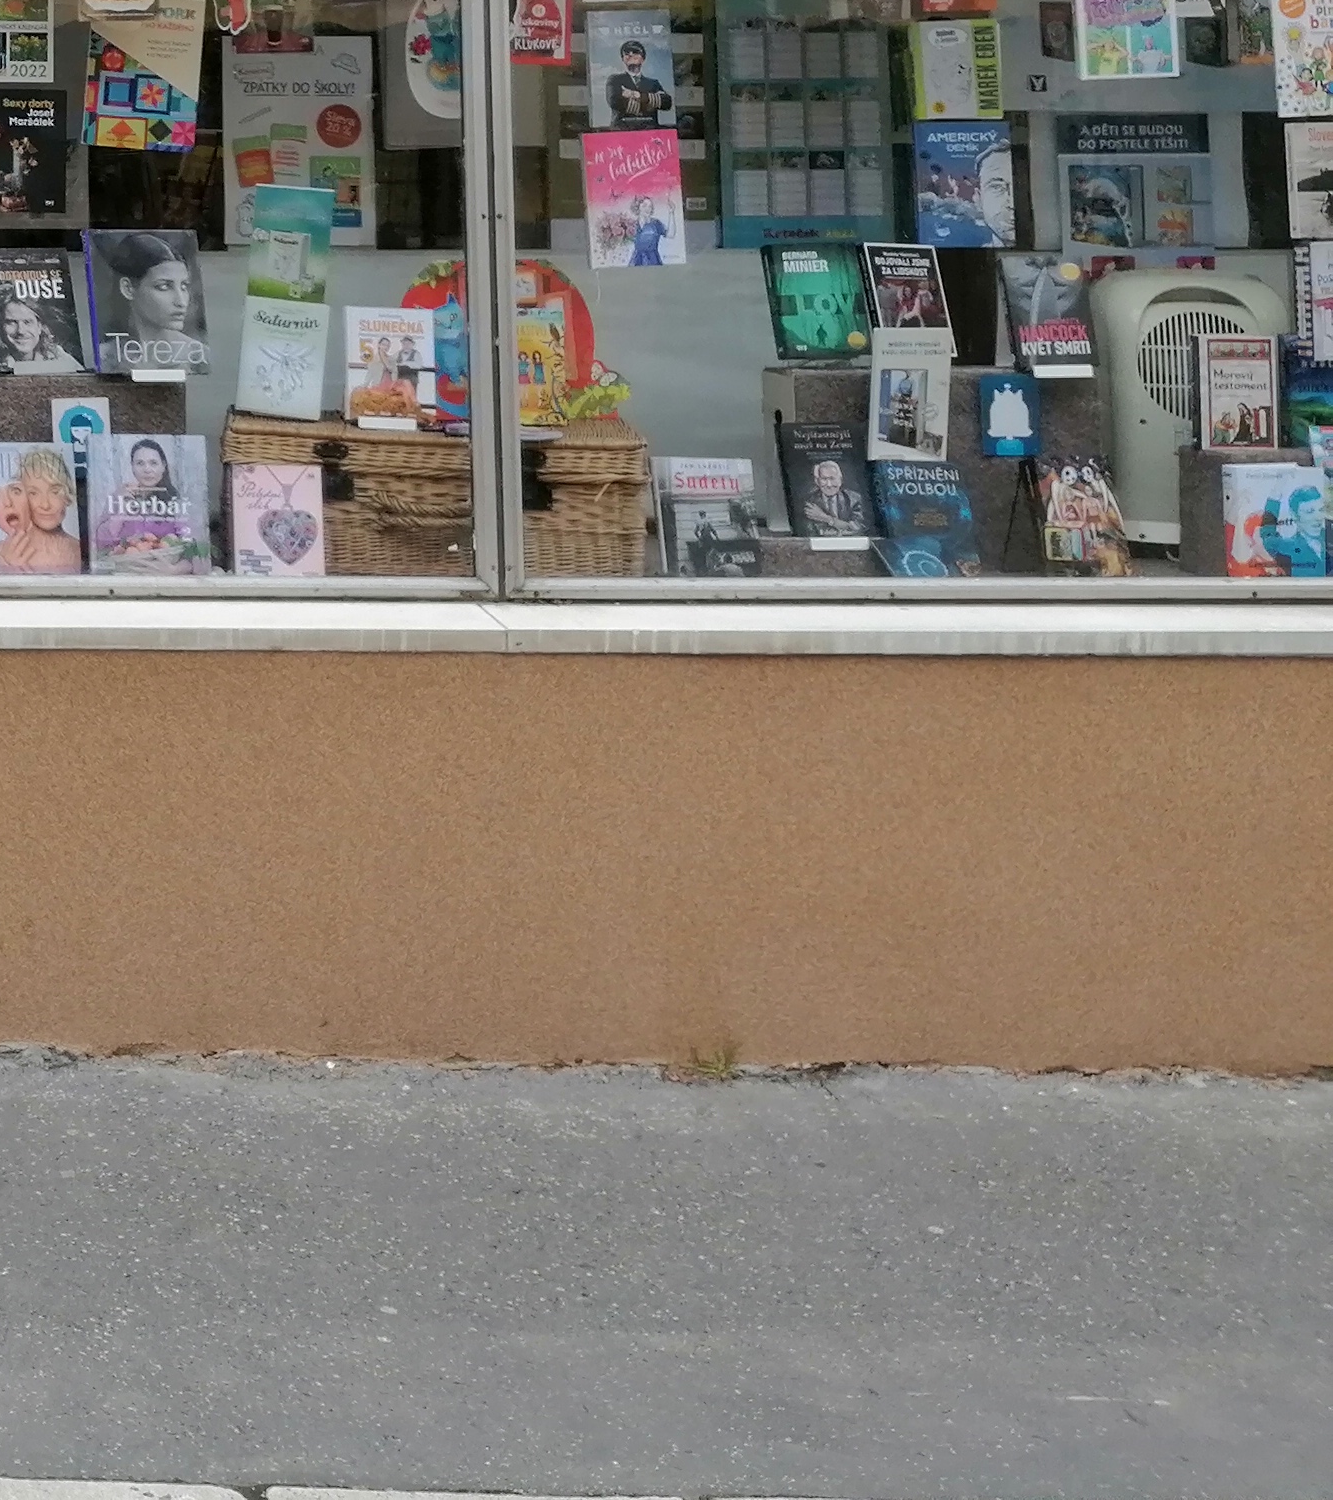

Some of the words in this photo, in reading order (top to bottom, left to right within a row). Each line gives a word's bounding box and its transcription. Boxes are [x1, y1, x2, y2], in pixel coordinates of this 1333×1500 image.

[10, 64, 47, 78] 2022
[293, 82, 310, 94] DO
[2, 97, 27, 110] Sexy
[927, 129, 1000, 143] AMERICKÝ
[783, 260, 830, 273] MINIER
[253, 309, 320, 331] Saturnin
[1019, 324, 1089, 342] HANCOCK
[105, 332, 208, 365] Tereza
[1021, 338, 1052, 357] KVĚT
[1054, 340, 1091, 355] SMRTI
[895, 481, 957, 497] VOLBOU
[108, 493, 193, 516] Herbář
